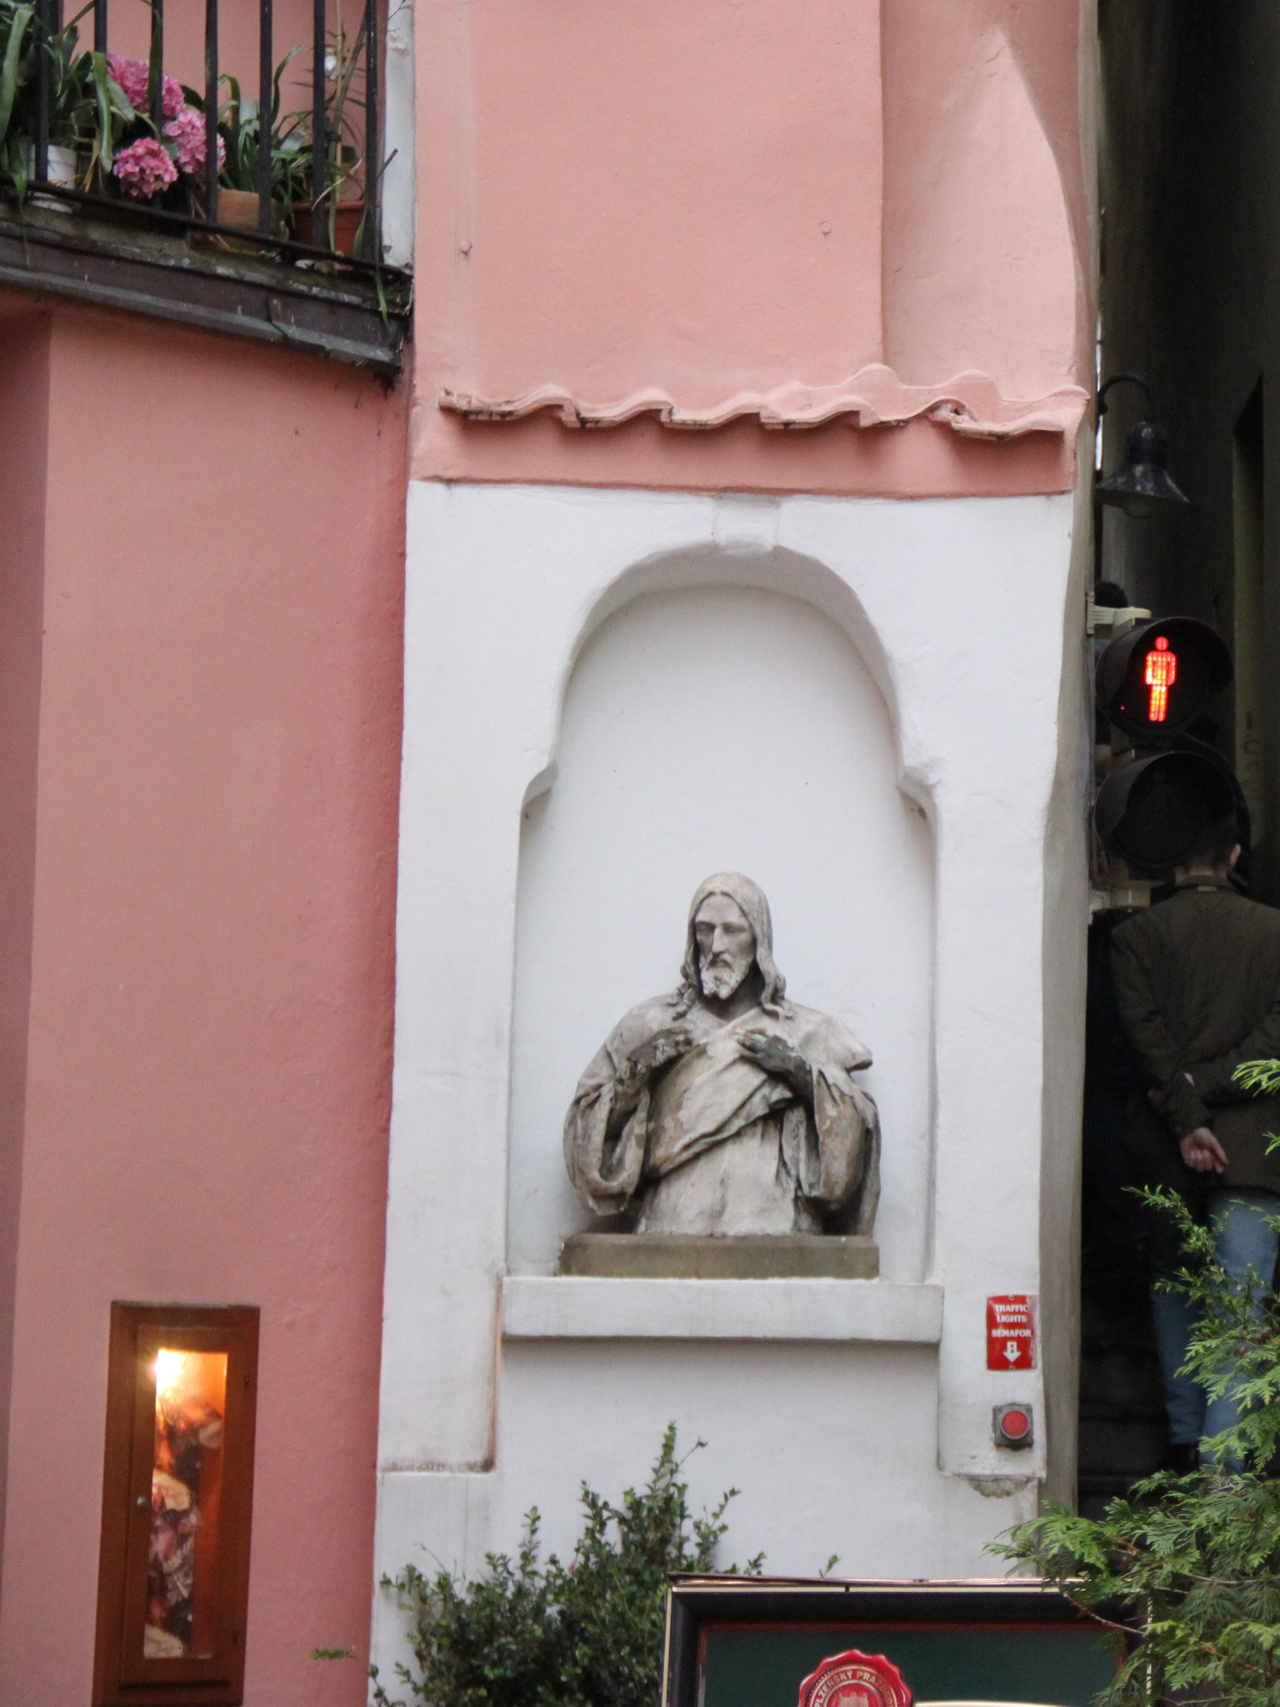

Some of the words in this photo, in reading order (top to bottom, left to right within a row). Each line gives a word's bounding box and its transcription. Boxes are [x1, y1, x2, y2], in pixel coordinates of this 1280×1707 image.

[995, 1304, 1029, 1313] TRAFFIC
[996, 1314, 1028, 1323] LIGHTS
[991, 1329, 1032, 1338] SEMAFOR
[856, 1671, 894, 1707] PRAZDRO
